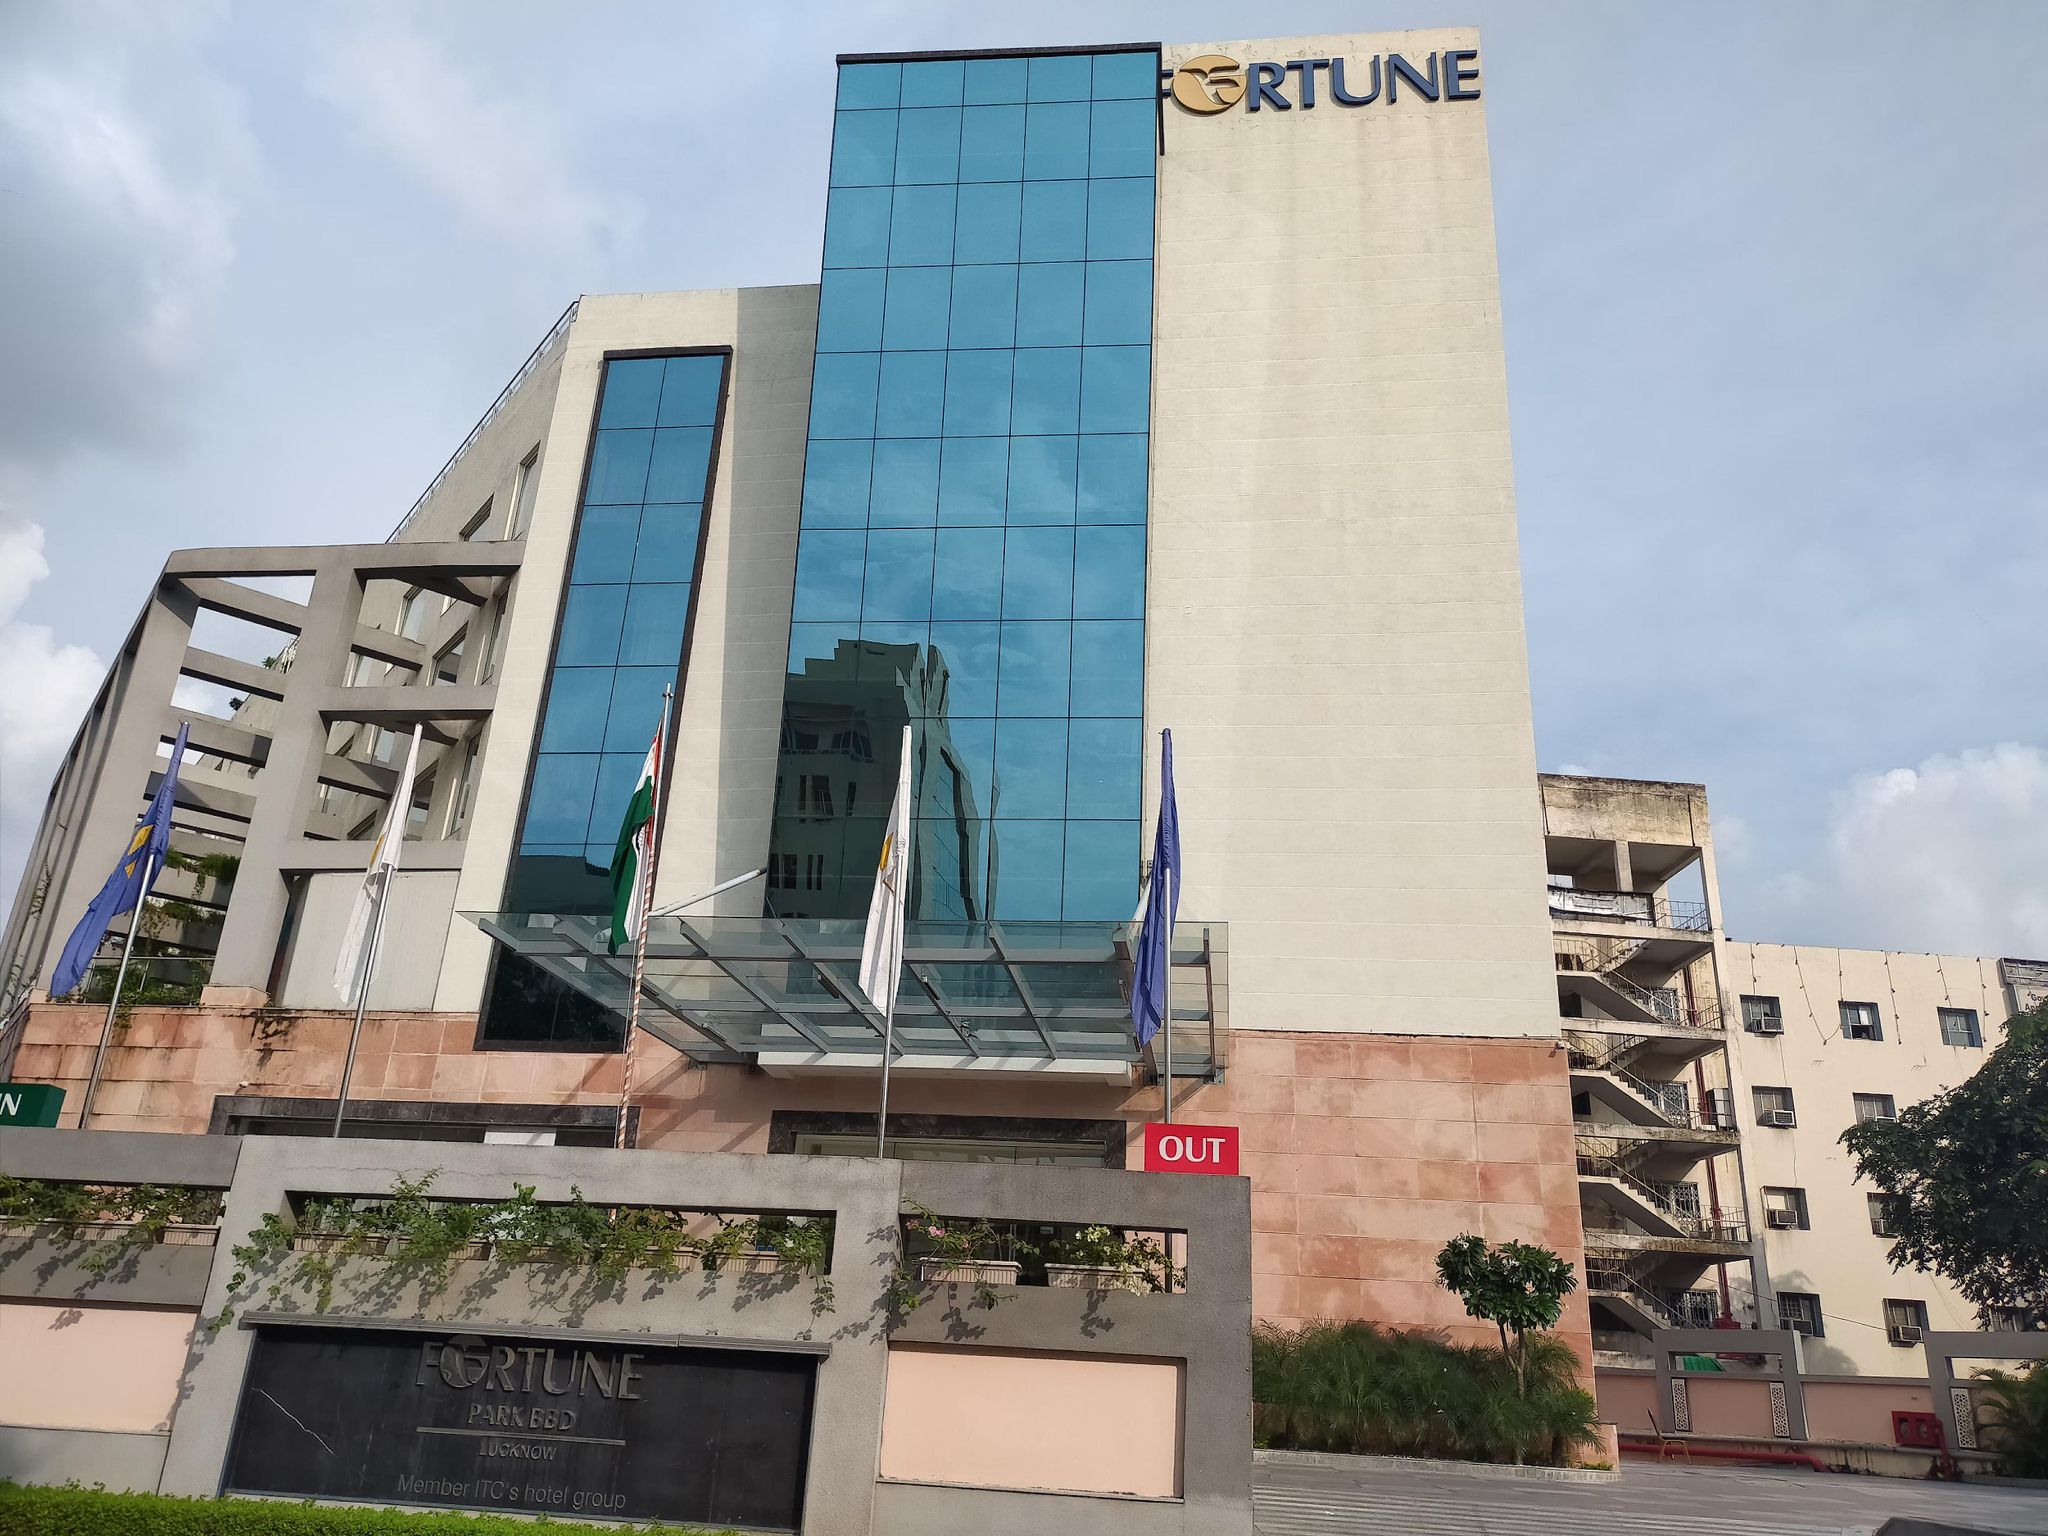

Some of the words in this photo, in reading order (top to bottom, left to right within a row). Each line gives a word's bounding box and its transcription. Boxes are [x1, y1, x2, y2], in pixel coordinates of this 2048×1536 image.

[1158, 1135, 1226, 1163] OUT
[416, 1334, 645, 1399] FORTUNE
[467, 1403, 523, 1427] PARK
[529, 1408, 577, 1430] BBD
[478, 1438, 557, 1460] LUCKNOW
[398, 1474, 470, 1497] Member
[475, 1480, 519, 1501] ITC's
[524, 1484, 569, 1504] hotel
[573, 1491, 626, 1512] group
